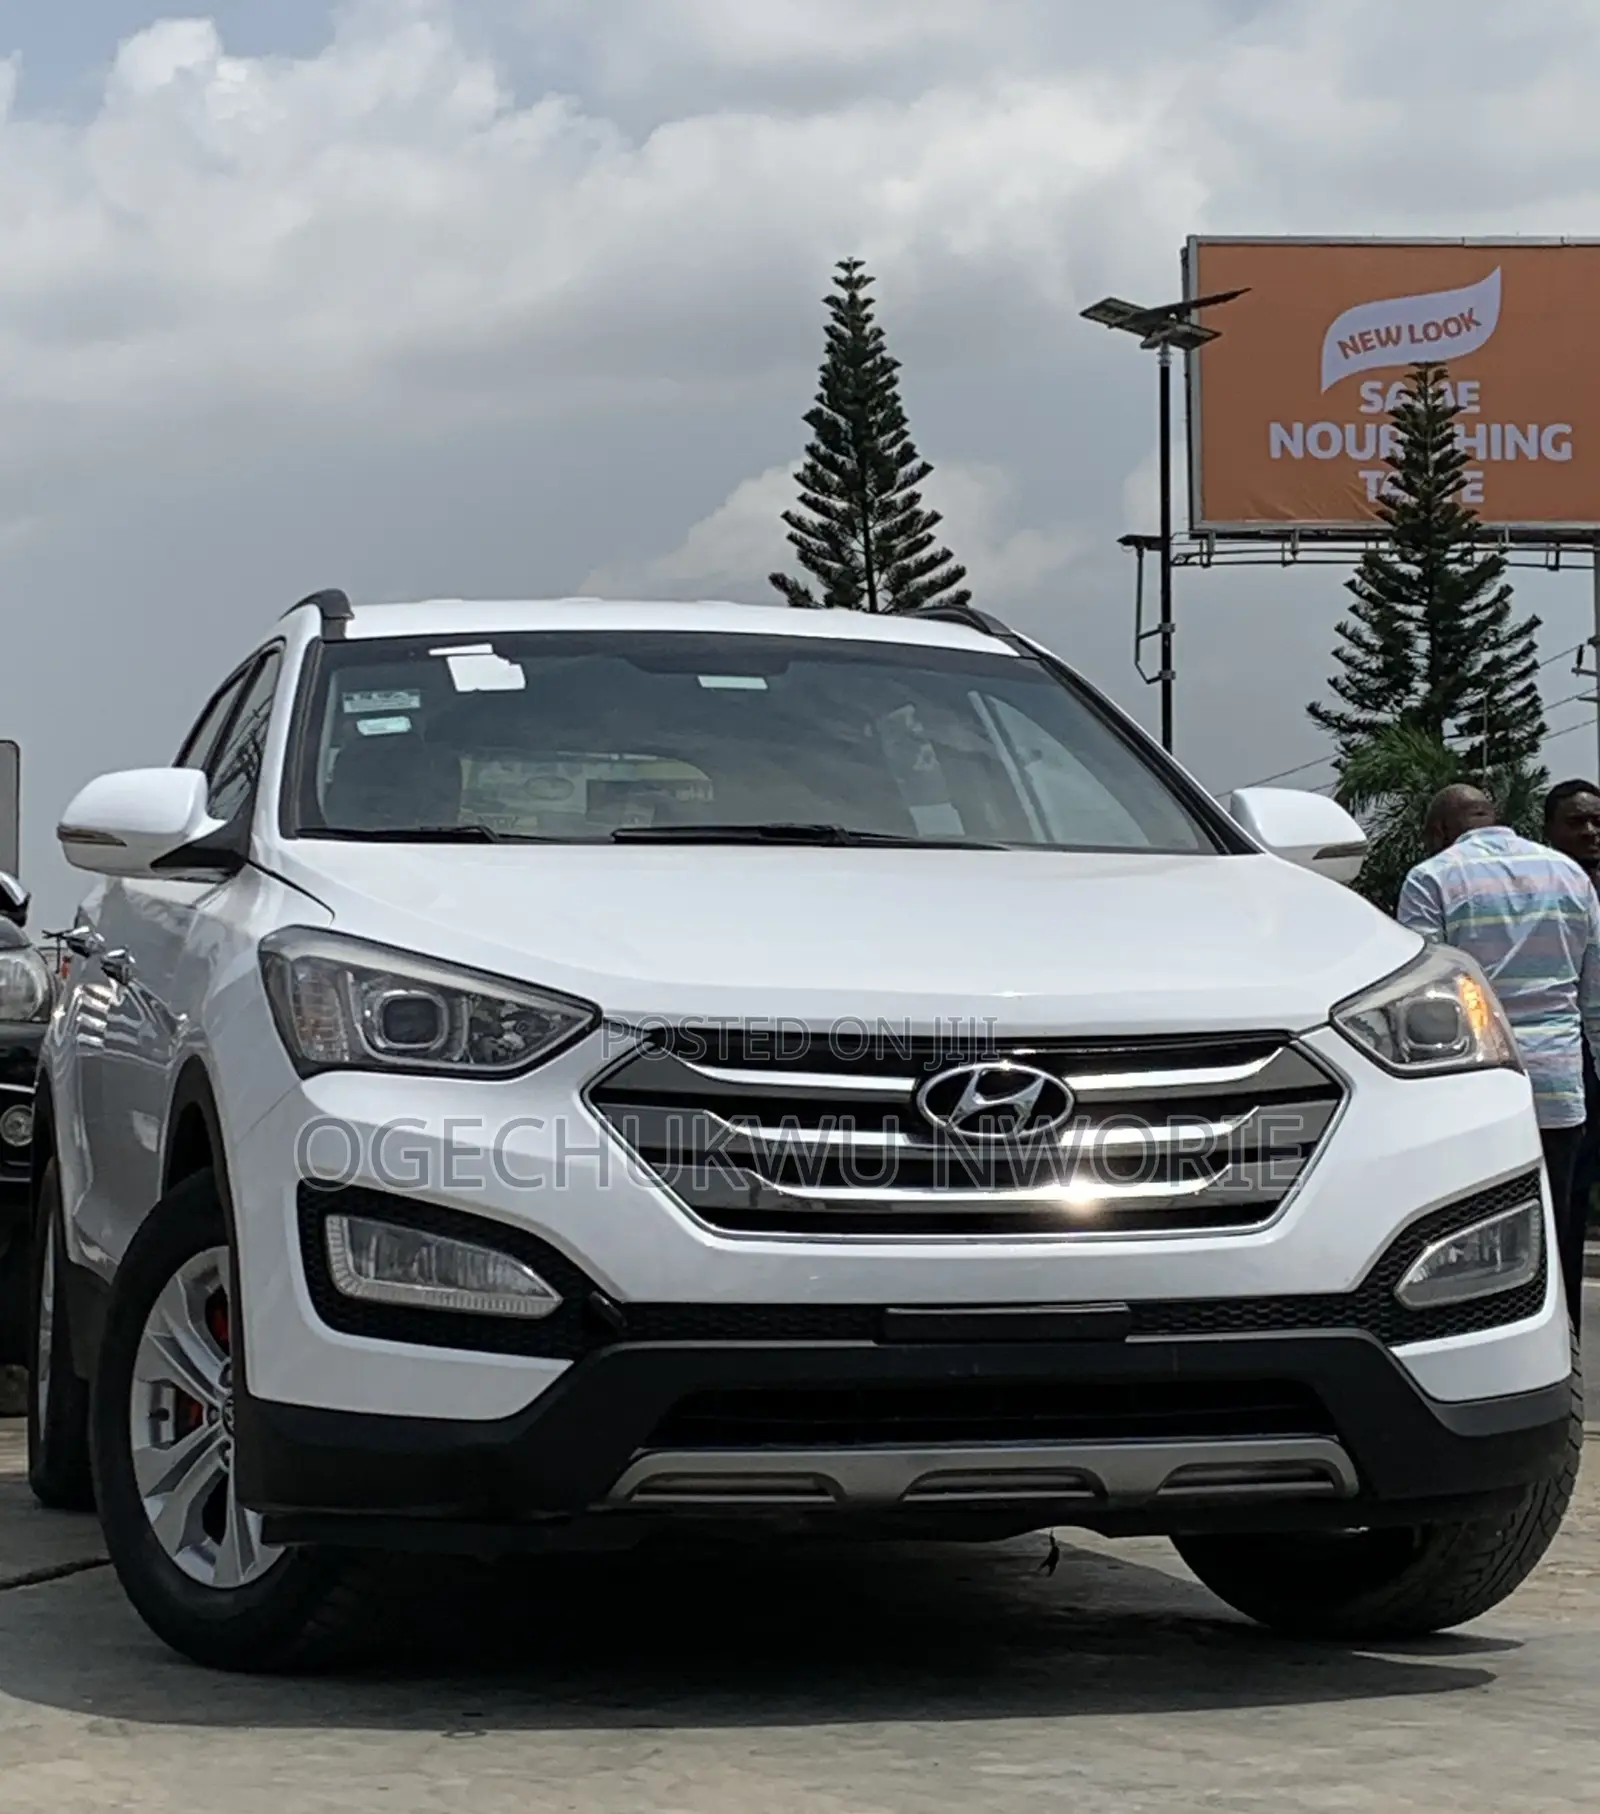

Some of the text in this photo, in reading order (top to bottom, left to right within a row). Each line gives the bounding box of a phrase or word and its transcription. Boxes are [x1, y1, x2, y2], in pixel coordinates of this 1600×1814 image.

[1337, 307, 1483, 360] NEW LOOK
[1269, 422, 1572, 460] NOURHING
[1358, 469, 1484, 502] TAE
